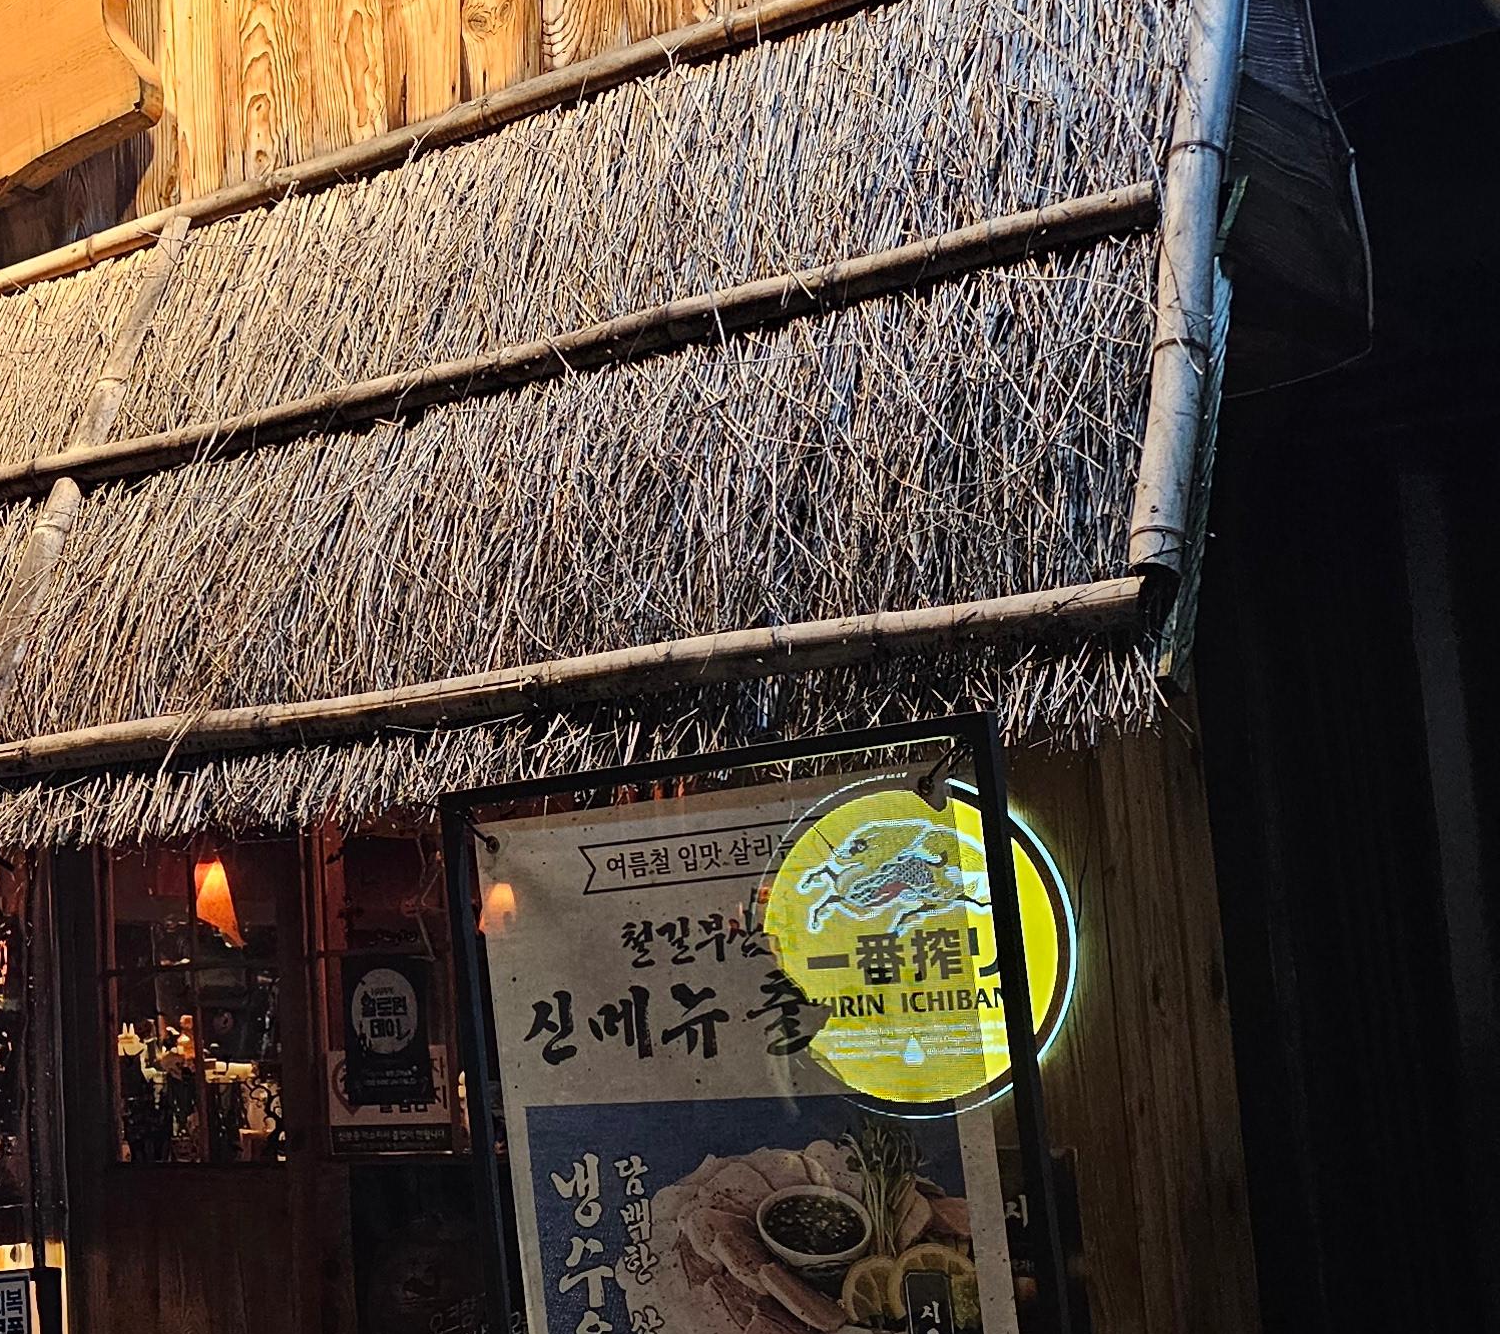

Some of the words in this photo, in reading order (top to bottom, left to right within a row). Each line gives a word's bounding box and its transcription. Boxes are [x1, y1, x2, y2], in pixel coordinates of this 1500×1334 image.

[606, 846, 672, 880] 여름철
[677, 841, 723, 871] 입맛
[620, 909, 774, 968] 철길부산
[524, 983, 730, 1065] 신메뉴
[614, 1155, 658, 1285] 담백한
